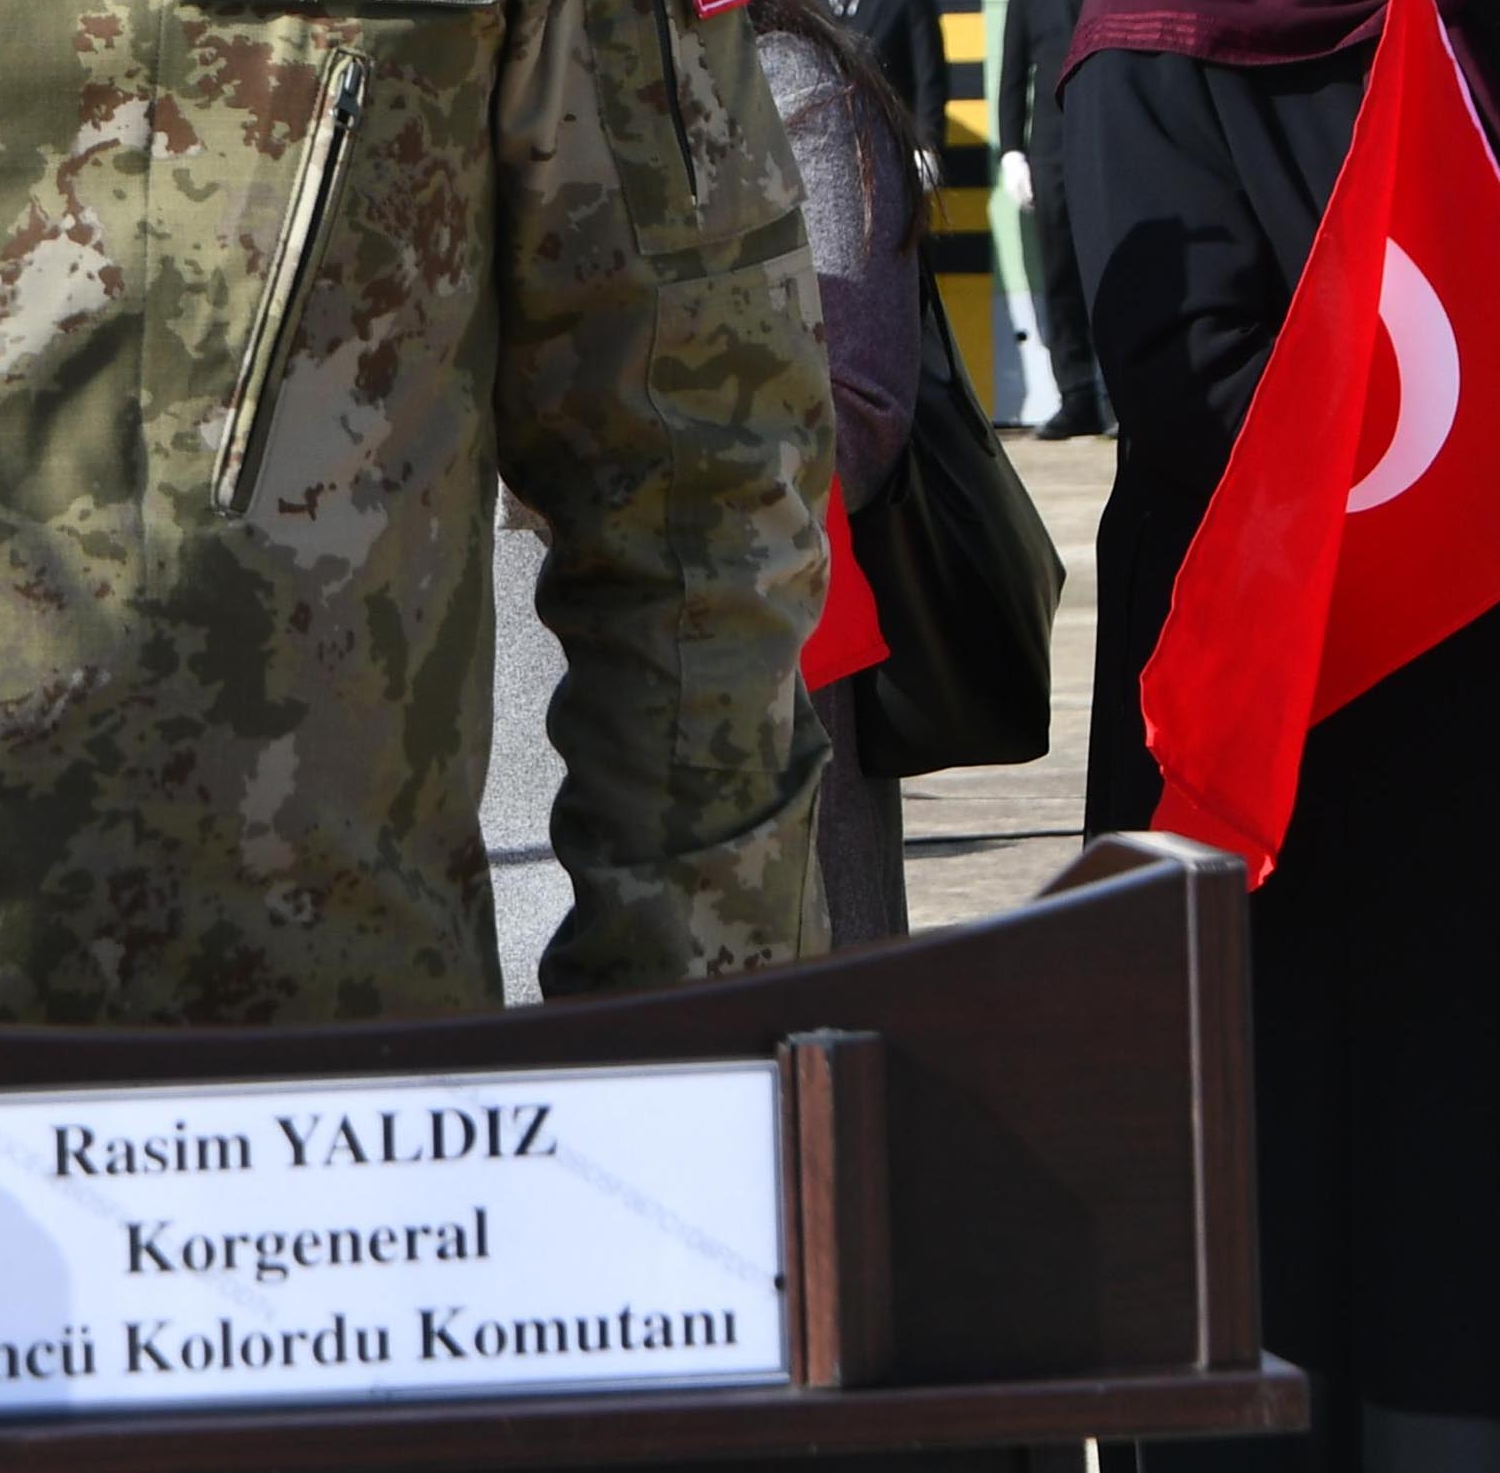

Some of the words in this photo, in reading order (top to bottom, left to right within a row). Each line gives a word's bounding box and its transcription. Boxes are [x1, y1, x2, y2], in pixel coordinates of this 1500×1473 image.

[53, 1121, 252, 1177] Rasim
[276, 1104, 557, 1167] YALDIZ
[125, 1207, 490, 1283] Korgeneral
[125, 1312, 390, 1373] Kolordu
[418, 1305, 738, 1360] Komutanı
